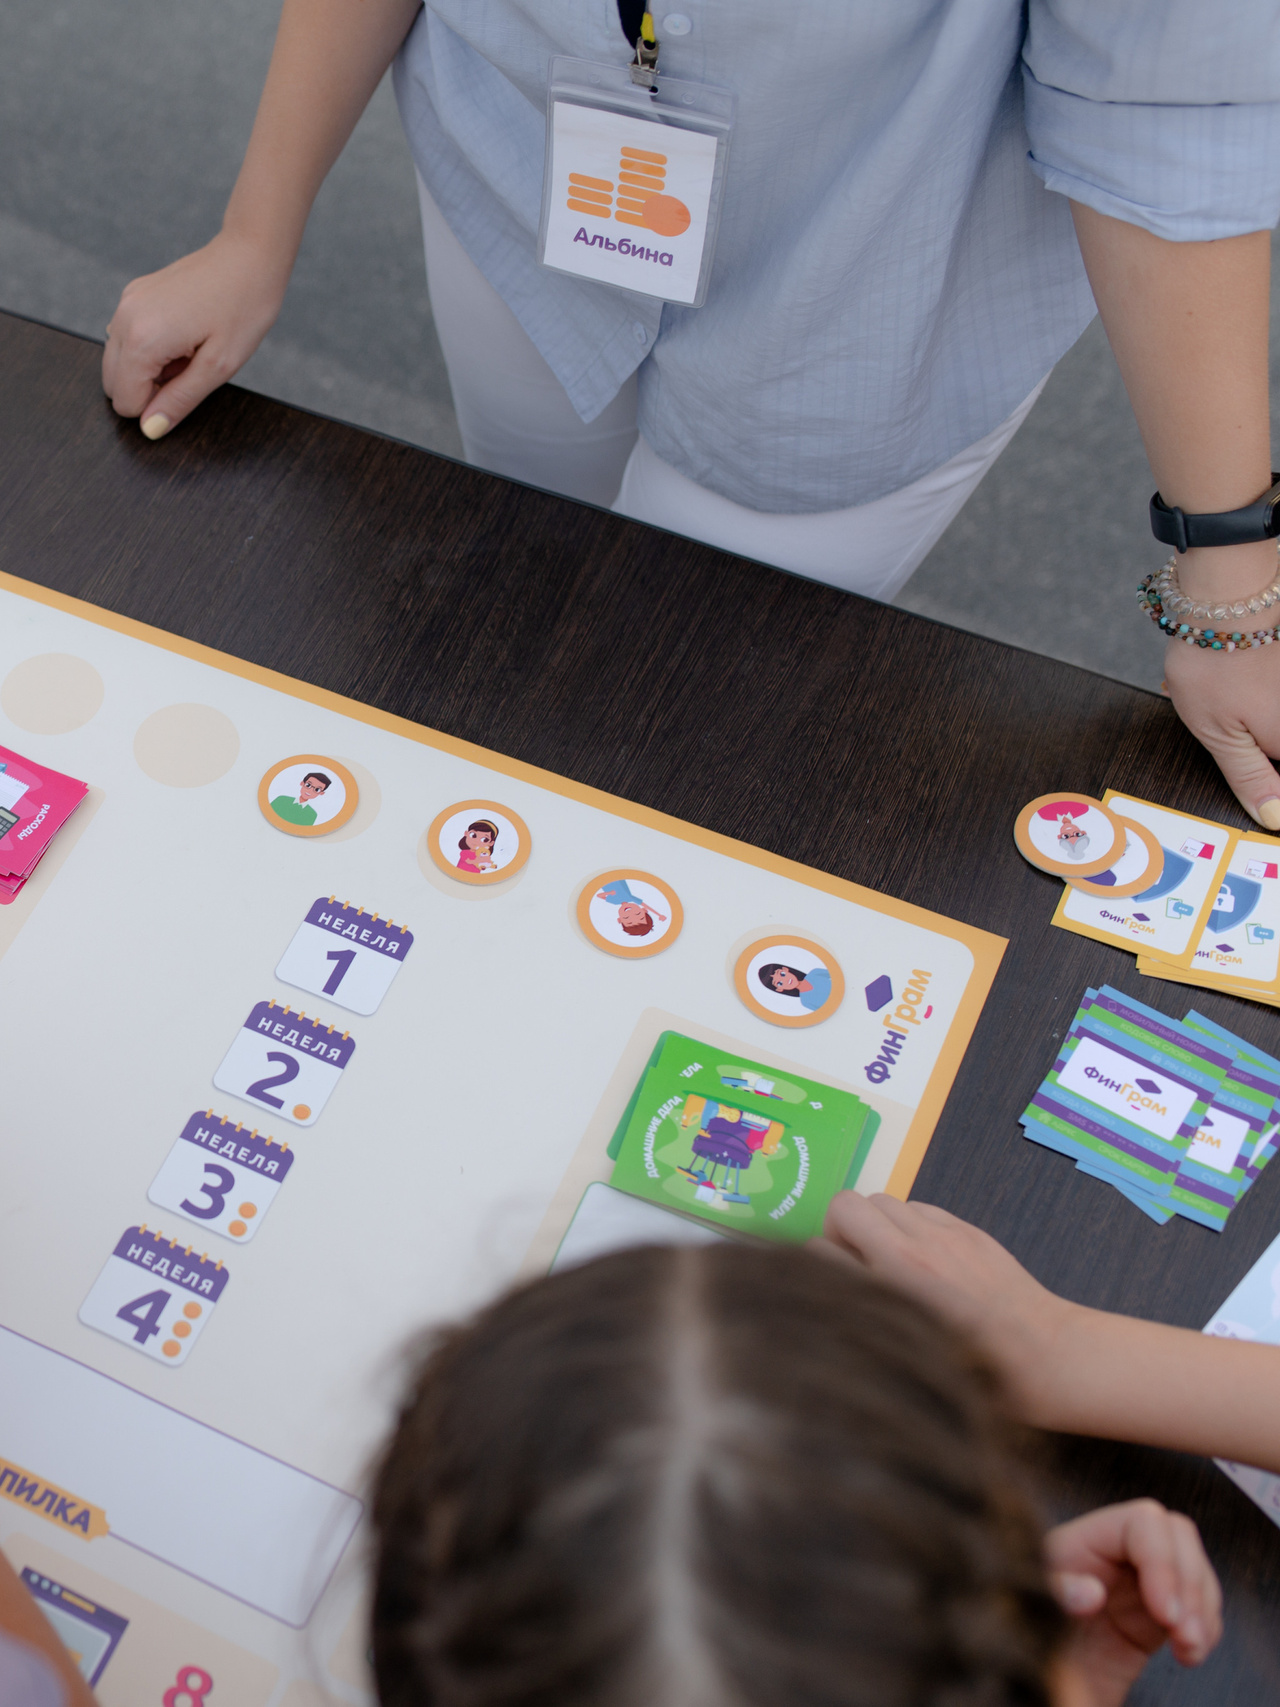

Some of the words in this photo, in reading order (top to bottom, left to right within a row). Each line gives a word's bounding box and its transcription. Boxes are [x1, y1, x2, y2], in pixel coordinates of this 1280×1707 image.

[573, 227, 674, 267] Альбина
[17, 803, 51, 841] РАСХОДЫ
[317, 910, 401, 955] НЕДЕЛЯ
[1099, 910, 1156, 935] ФинГрам
[321, 948, 358, 997] 1
[1194, 949, 1243, 966] инГрам
[257, 1016, 342, 1062] НЕДЕЛЯ
[864, 968, 933, 1084] ФинГрам
[679, 1061, 704, 1079] ЕЛА
[1162, 1044, 1192, 1062] СЛОВО
[1228, 1069, 1252, 1082] ОМЕР
[245, 1051, 301, 1110] 2
[1083, 1065, 1168, 1117] ФинГрам
[1221, 1081, 1239, 1091] ОВО
[192, 1126, 281, 1176] НЕДЕЛЯ
[644, 1116, 663, 1179] ДОМАШНИЕ
[657, 1095, 684, 1118] ДЕЛА
[792, 1135, 811, 1198] ДОМАШНИЕ
[179, 1162, 236, 1220] 3
[769, 1197, 797, 1220] ДЕЛА
[125, 1242, 215, 1296] НЕДЕЛЯ
[115, 1288, 172, 1346] 4
[162, 1664, 214, 1707] 8
